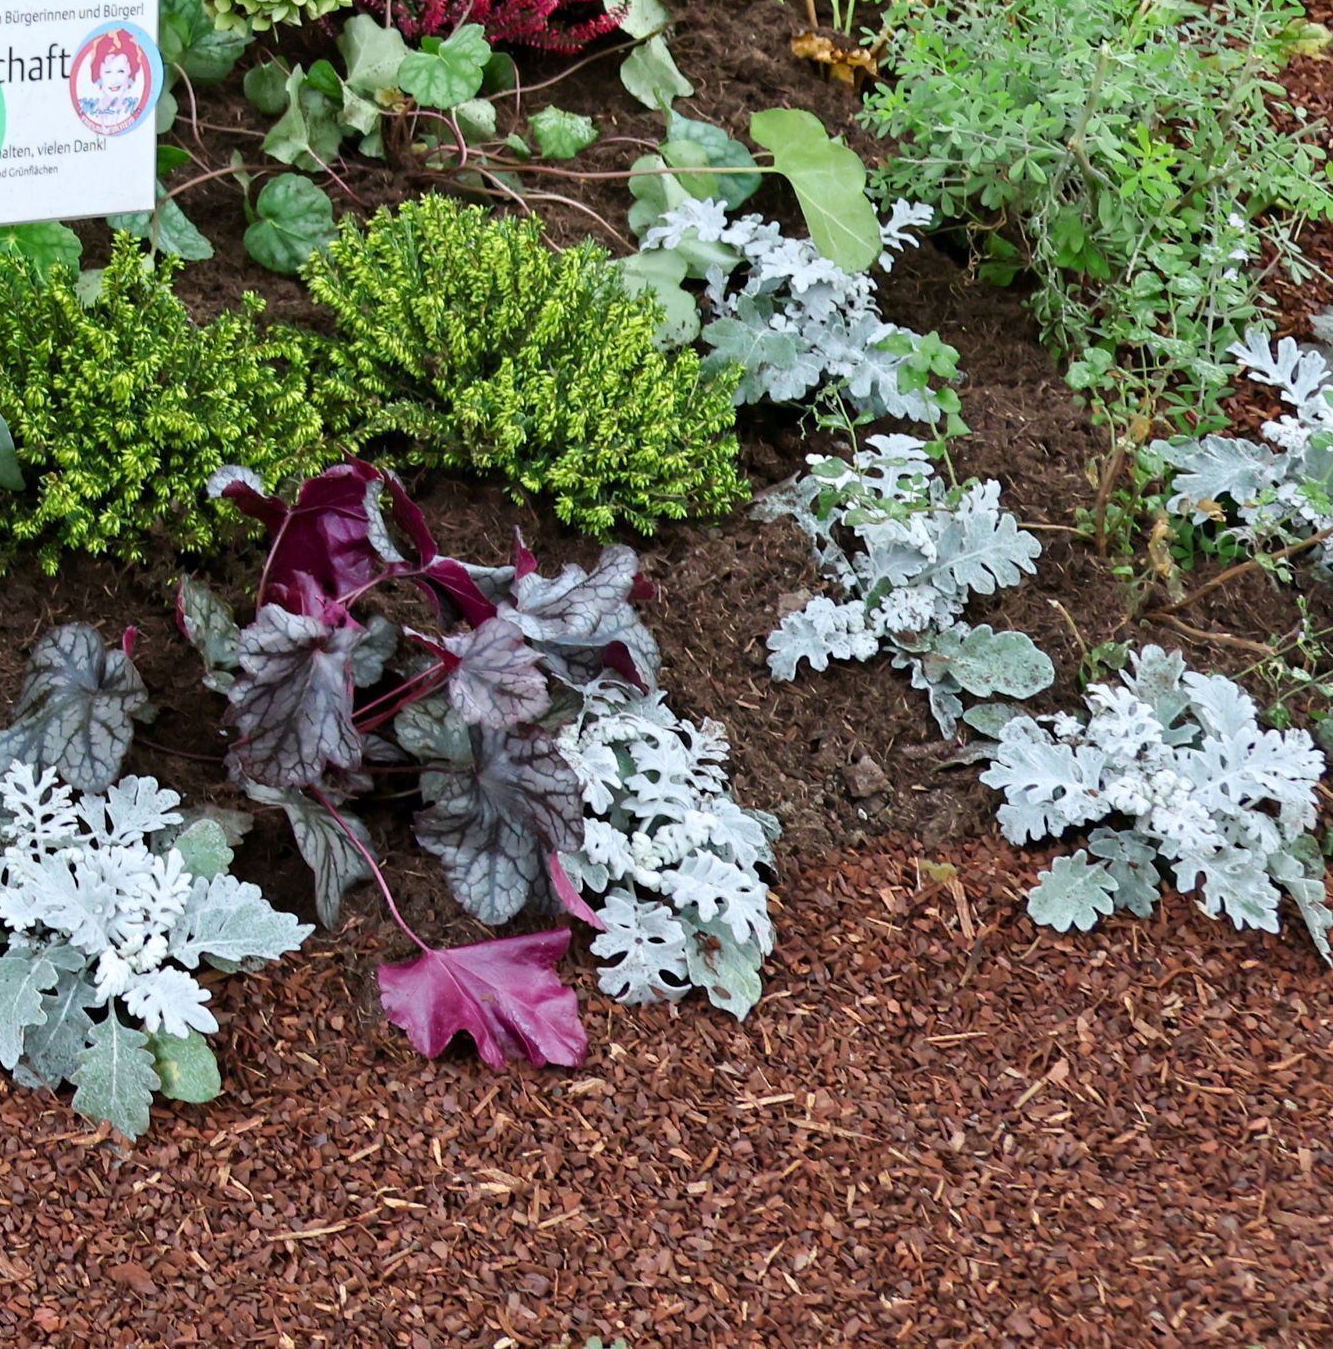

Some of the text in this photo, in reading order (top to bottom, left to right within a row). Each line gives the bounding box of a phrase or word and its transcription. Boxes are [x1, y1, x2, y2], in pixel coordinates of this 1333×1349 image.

[4, 7, 75, 26] Bürgerinnen
[78, 4, 101, 19] und
[37, 141, 71, 157] vielen
[8, 163, 59, 179] Grünflächen
